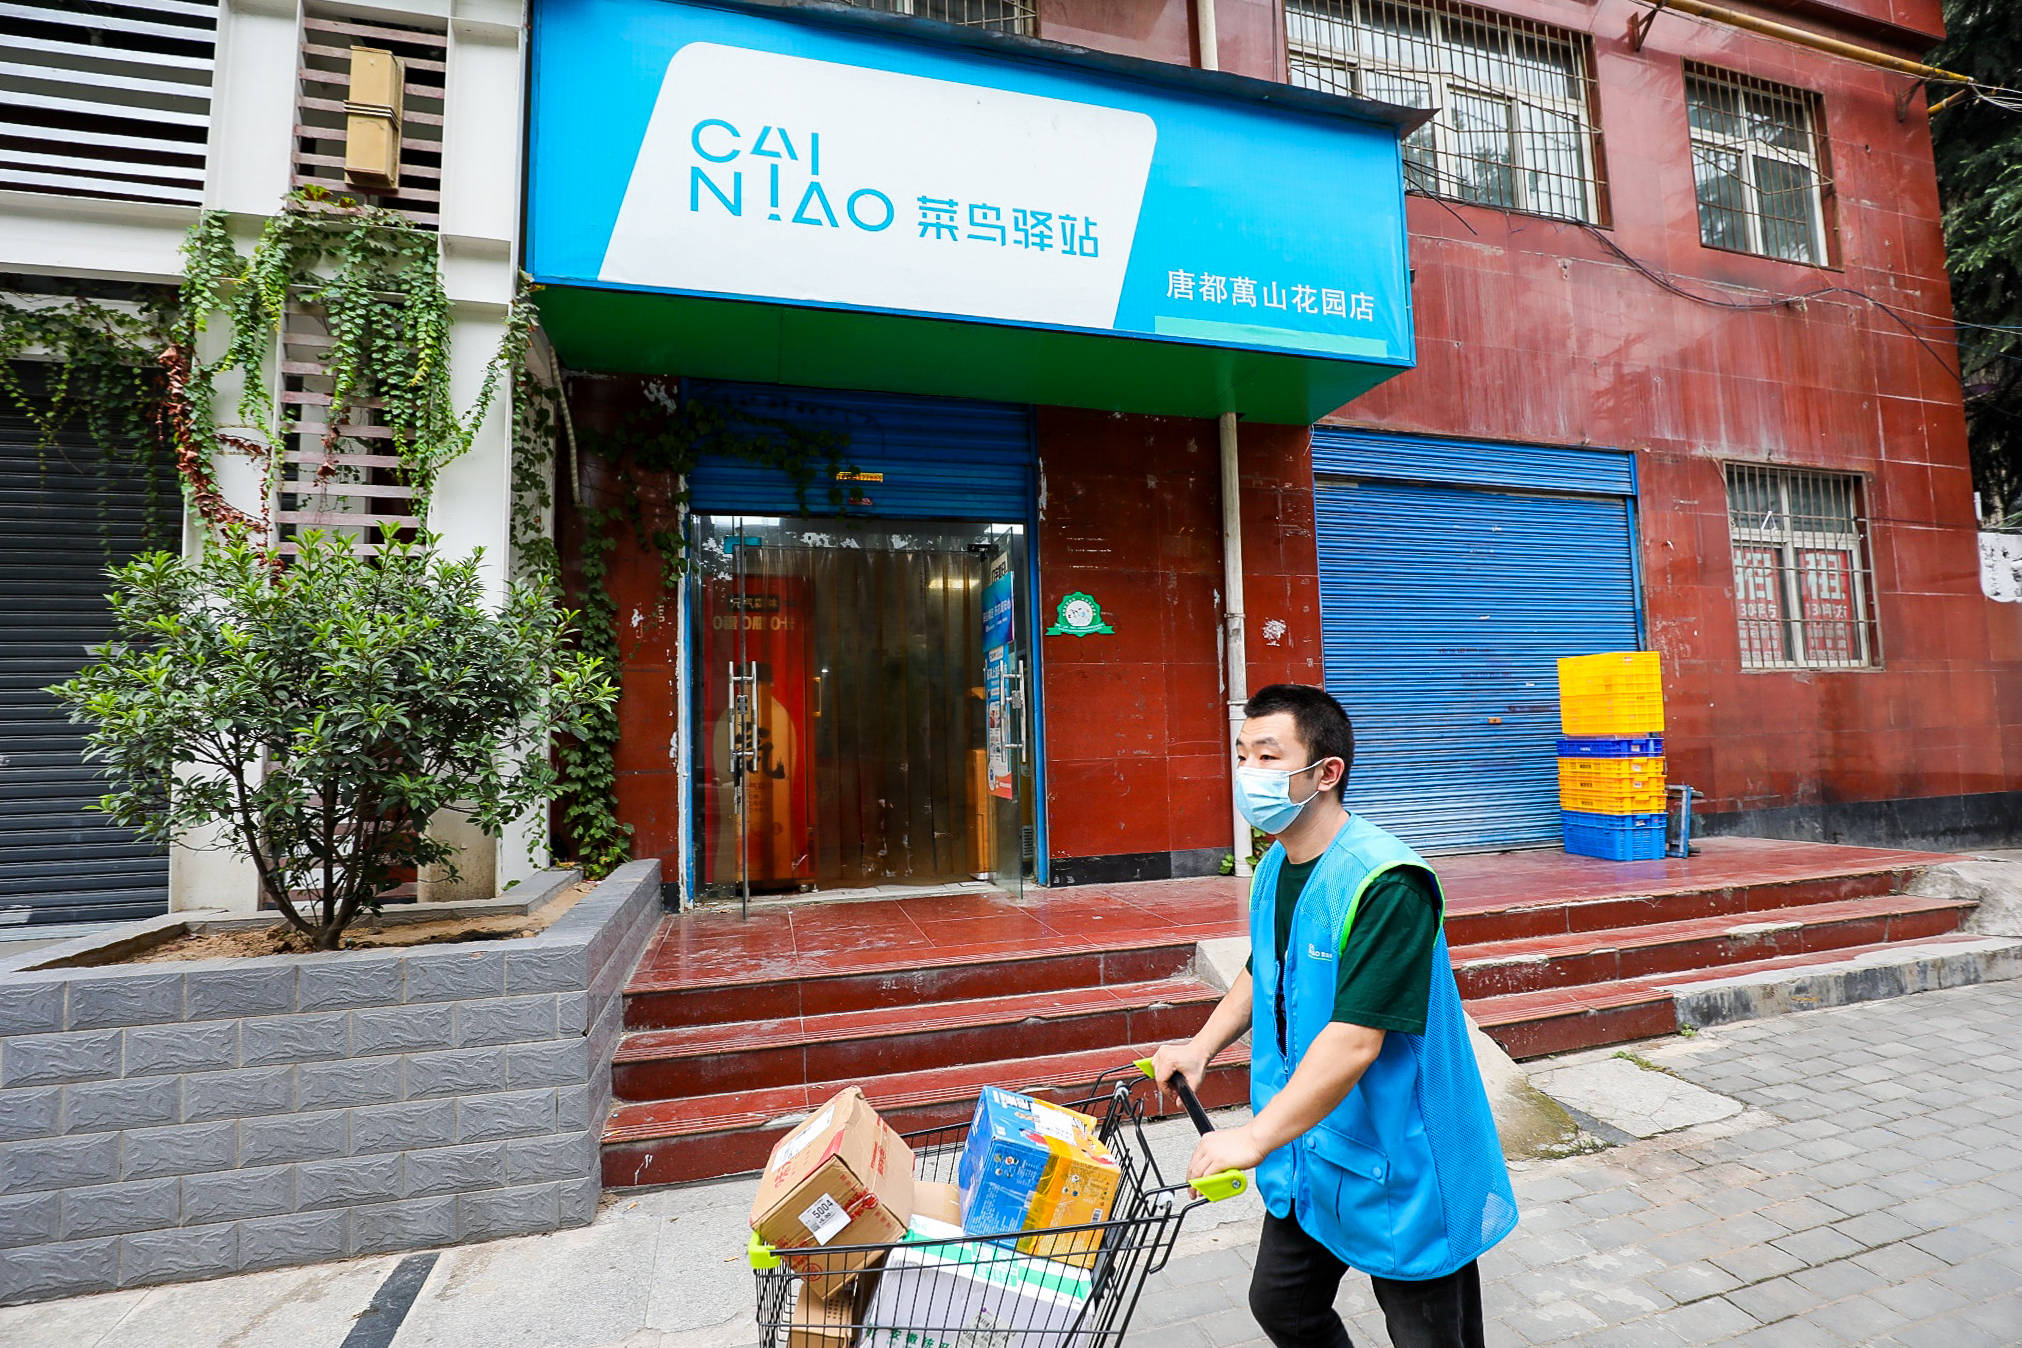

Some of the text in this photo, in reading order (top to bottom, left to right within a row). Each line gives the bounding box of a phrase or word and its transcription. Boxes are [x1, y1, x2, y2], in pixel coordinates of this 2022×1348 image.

[690, 117, 820, 177] CAI
[689, 163, 895, 232] NIAO
[916, 195, 1099, 258] 菜鸟驿站
[1166, 268, 1375, 323] 唐都萬山花园店
[811, 1199, 834, 1219] 5004
